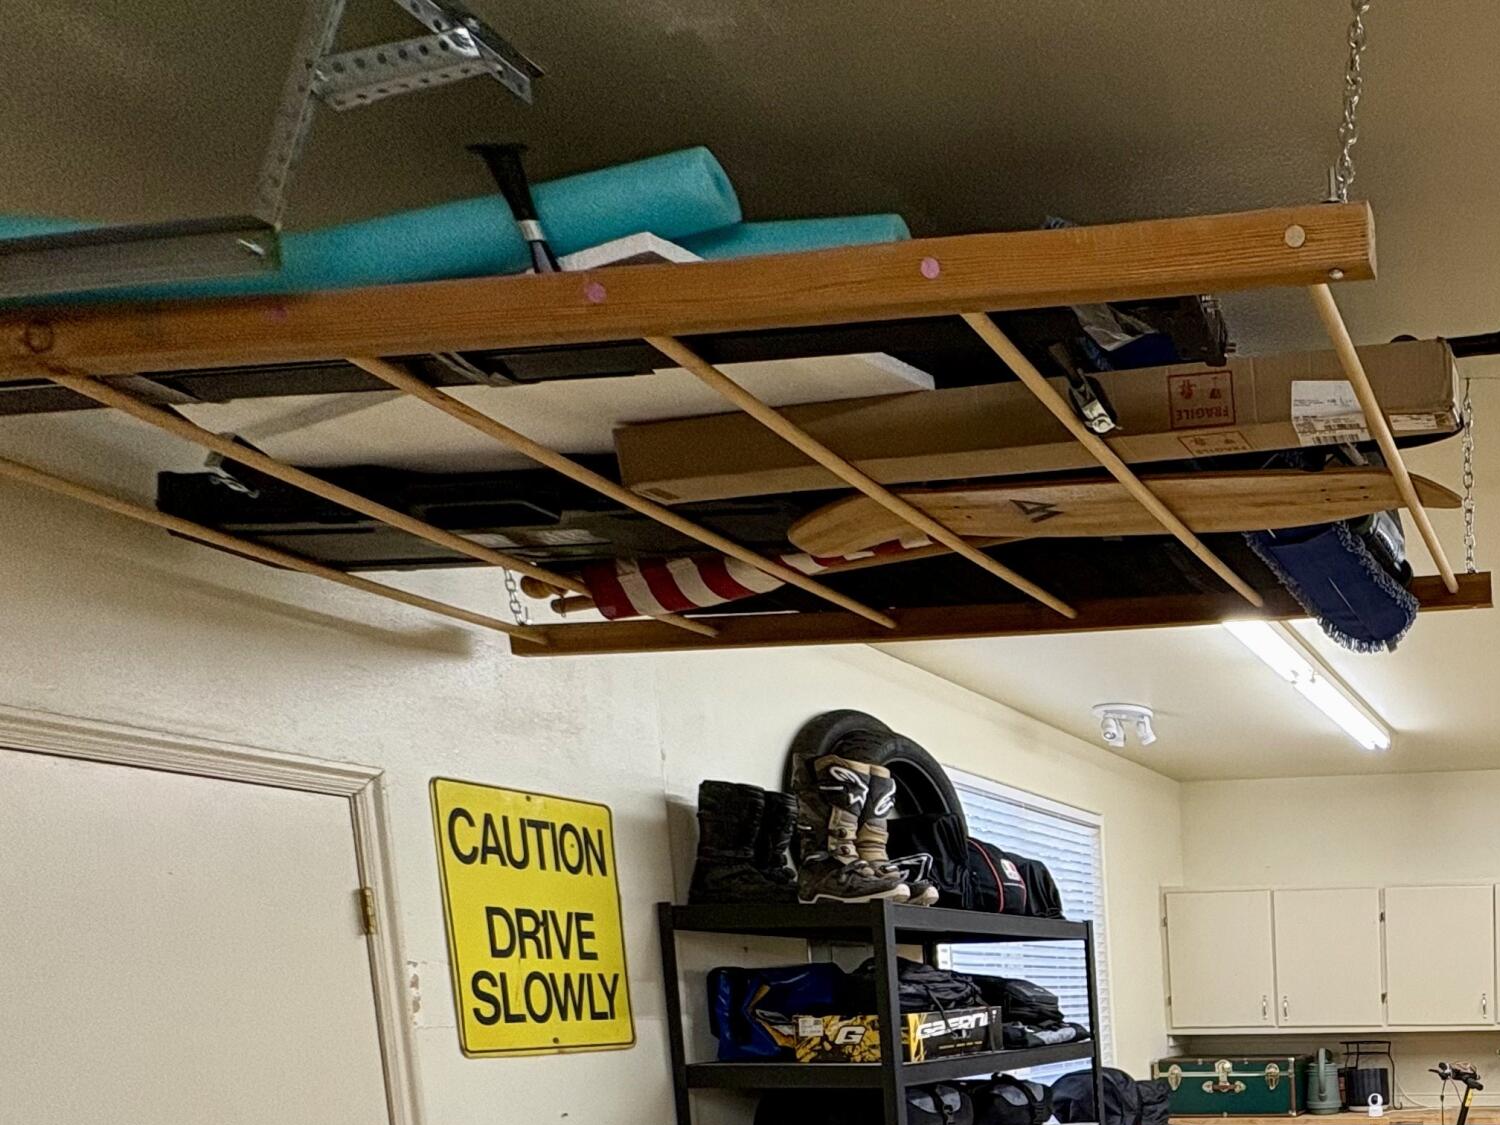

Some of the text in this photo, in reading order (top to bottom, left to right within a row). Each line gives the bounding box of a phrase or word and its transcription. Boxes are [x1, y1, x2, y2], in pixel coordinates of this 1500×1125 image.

[1175, 405, 1230, 421] FRAGILE
[447, 806, 608, 878] CAUTION
[484, 905, 599, 961] DRIVE
[470, 970, 620, 1026] SLOWLY
[834, 1025, 867, 1045] G
